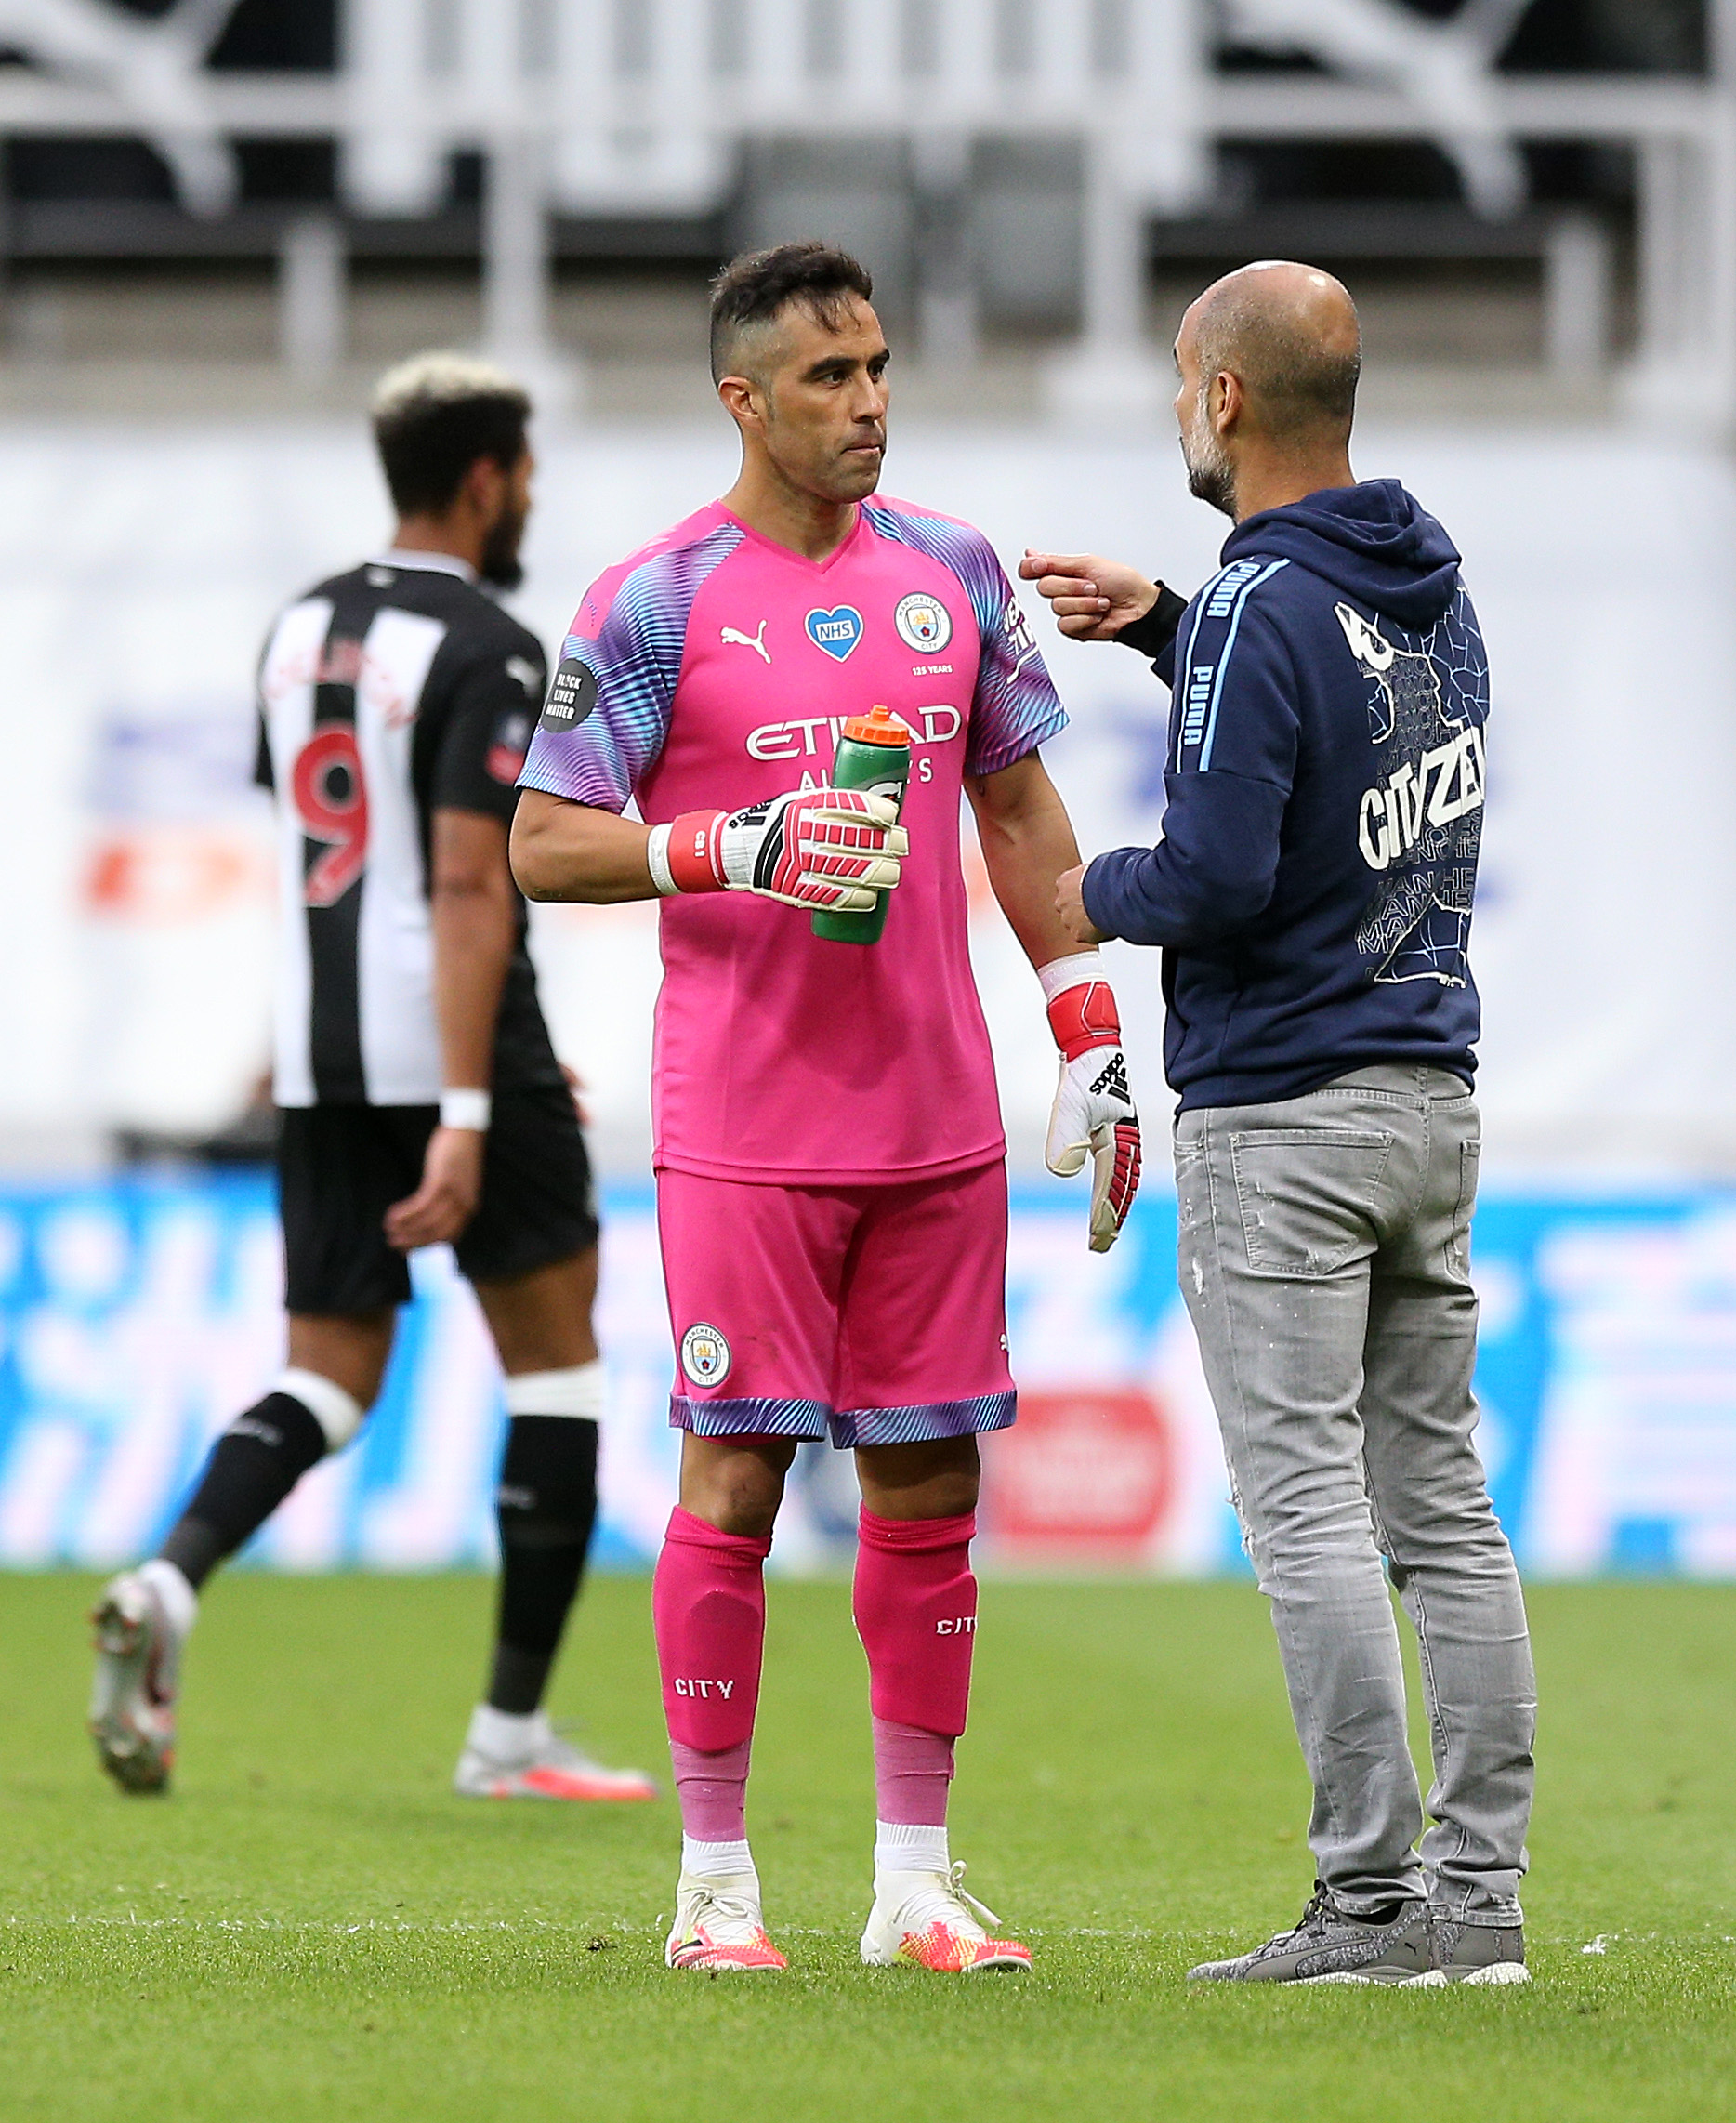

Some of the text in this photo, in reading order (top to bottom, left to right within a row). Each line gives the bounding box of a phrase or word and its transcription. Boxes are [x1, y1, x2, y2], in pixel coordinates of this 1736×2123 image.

[1206, 562, 1261, 618] PUMA
[899, 597, 942, 616] MANCHESTER
[820, 624, 850, 639] NHS
[913, 665, 953, 675] 125 YEARS
[553, 689, 576, 704] LIVES
[1184, 666, 1214, 745] PUMA
[546, 704, 574, 719] MATTER
[745, 704, 962, 760] ETIAD
[293, 721, 369, 905] 9
[695, 831, 705, 856] CB1
[686, 1327, 724, 1348] MANCHESTER
[936, 1617, 978, 1635] CIT
[675, 1678, 733, 1700] CITY
